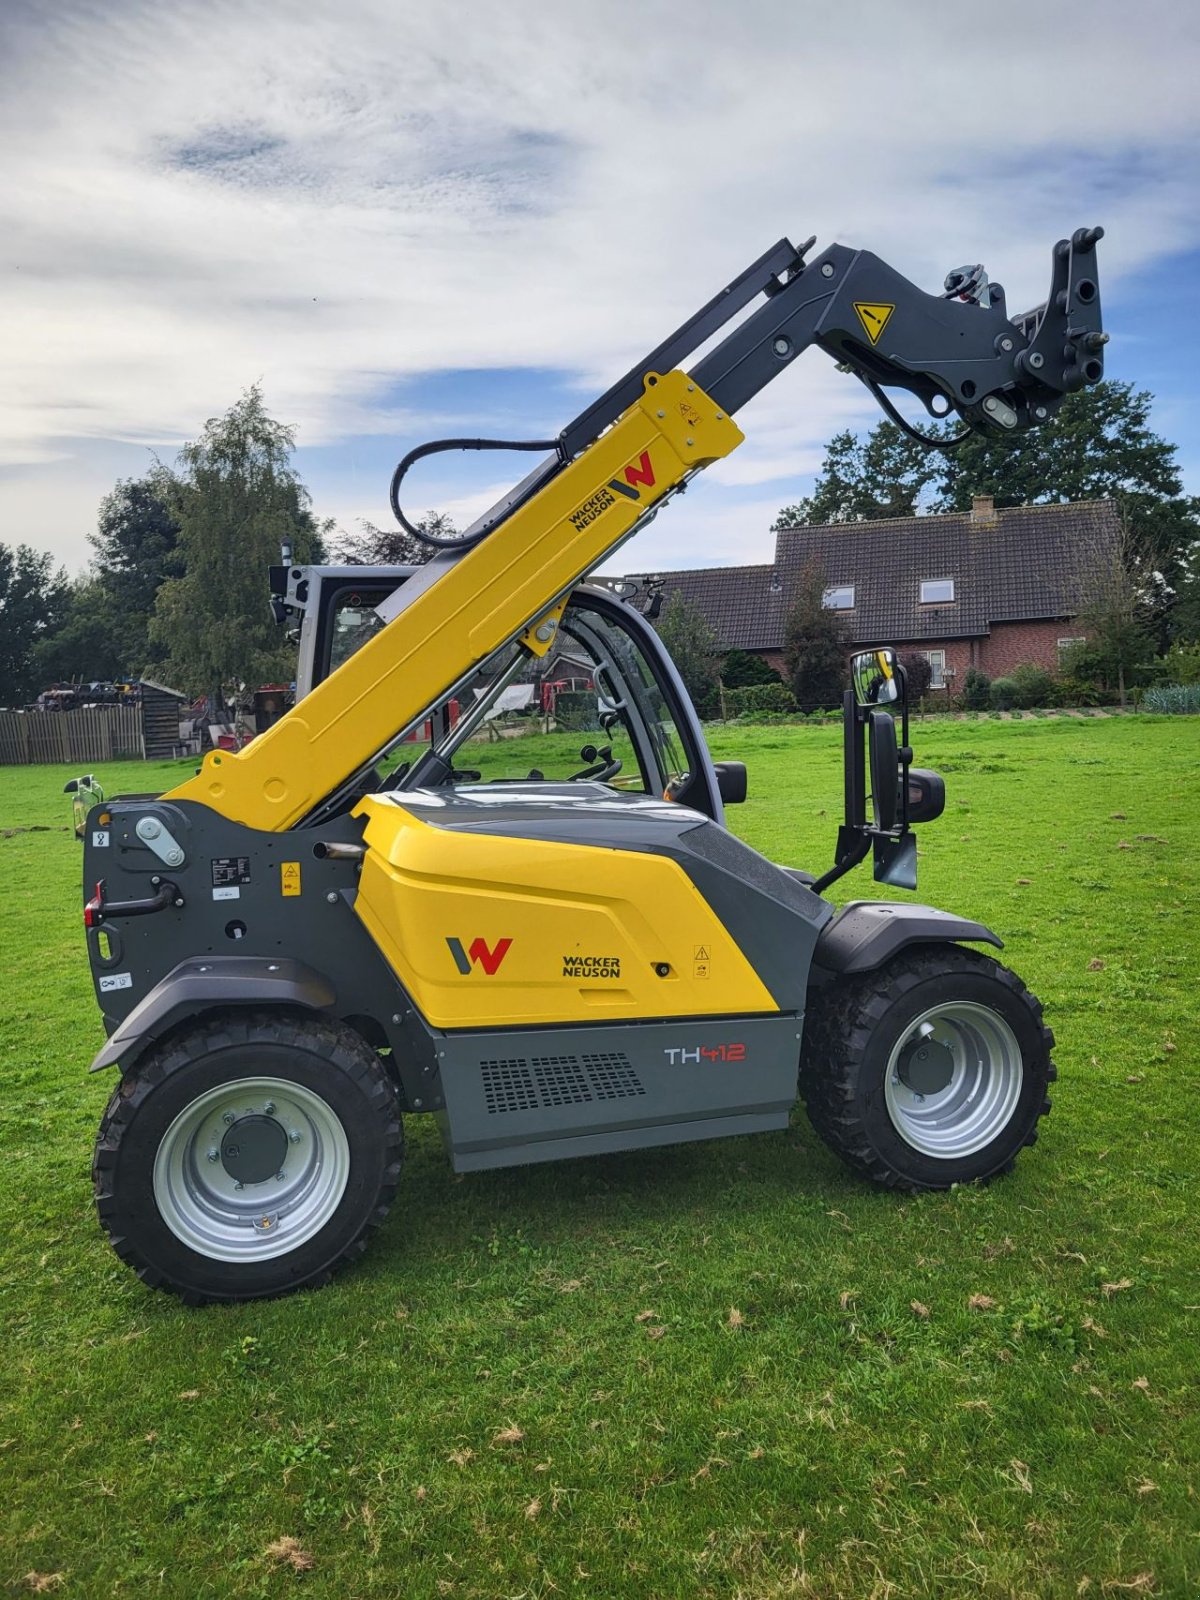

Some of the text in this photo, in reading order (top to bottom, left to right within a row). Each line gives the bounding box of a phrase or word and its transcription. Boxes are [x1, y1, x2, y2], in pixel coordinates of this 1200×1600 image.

[569, 489, 610, 524] WACKER
[575, 496, 615, 532] NEUSON
[562, 956, 620, 968] WACKER
[562, 966, 620, 978] NEUSON
[664, 1043, 746, 1065] TH412
